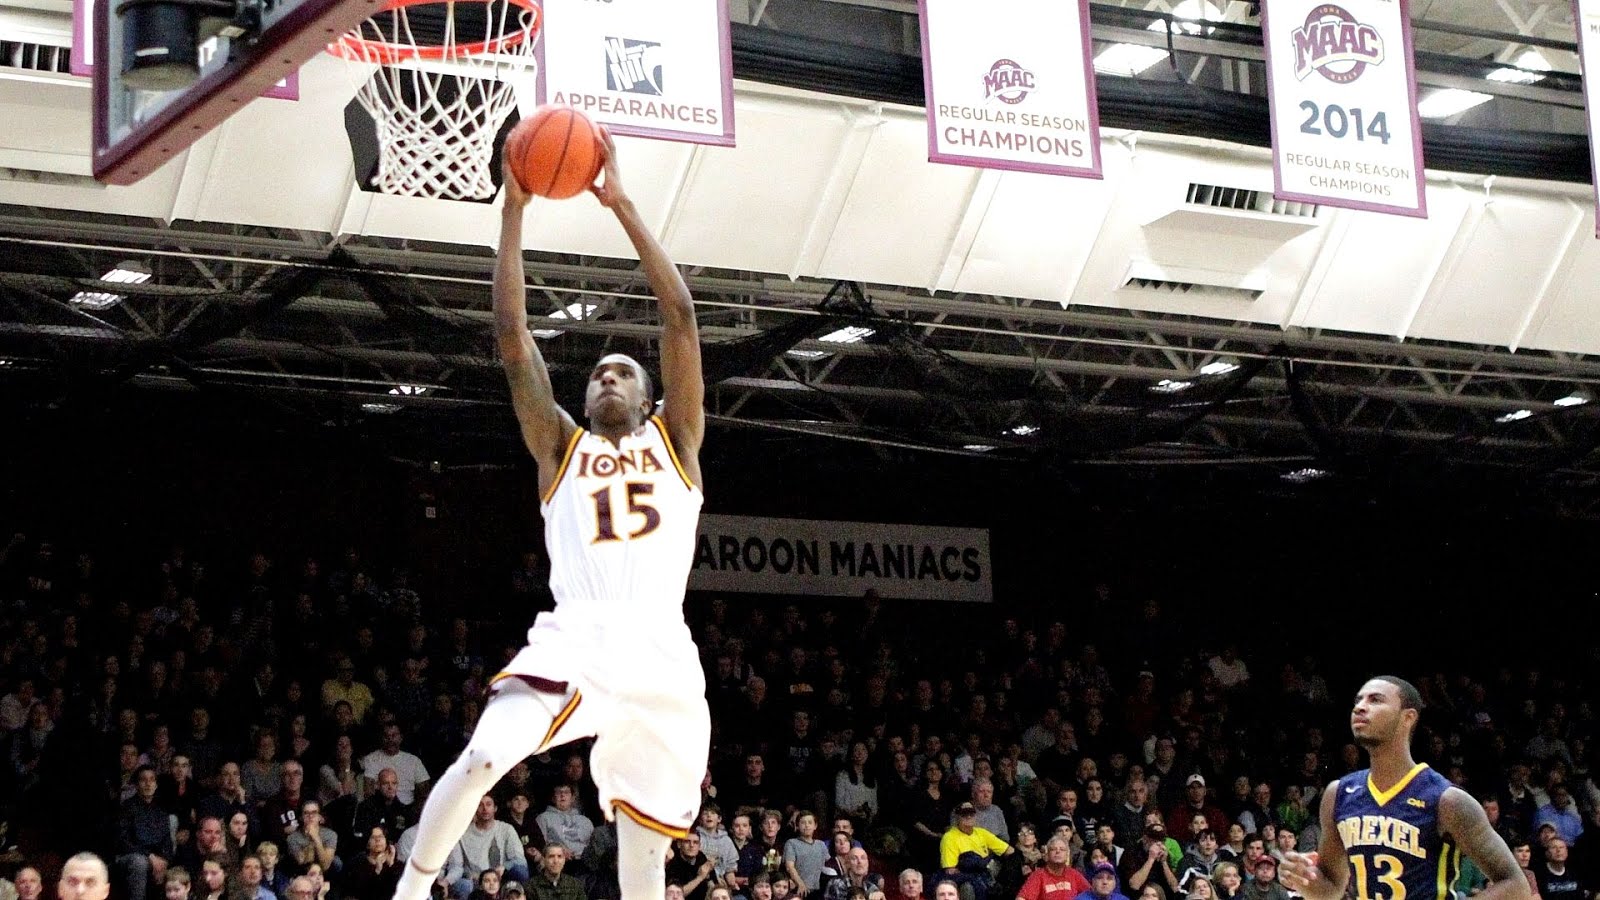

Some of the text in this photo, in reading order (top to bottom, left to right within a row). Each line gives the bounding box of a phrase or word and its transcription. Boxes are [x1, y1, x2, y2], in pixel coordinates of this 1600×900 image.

[1294, 24, 1379, 73] MAAC
[983, 69, 1036, 99] MAAC
[553, 91, 718, 125] APPEARANCES
[939, 104, 1086, 132] REGULAR SEASON
[1299, 100, 1391, 145] 2014
[944, 126, 1084, 158] CHAMPIONS
[1286, 153, 1410, 180] REGULAR SEASON
[1309, 175, 1391, 197] CHAMPIONS
[575, 446, 665, 478] IONA
[589, 481, 661, 545] 15
[692, 533, 982, 582] AROON MANIACS
[1350, 853, 1407, 900] 13
